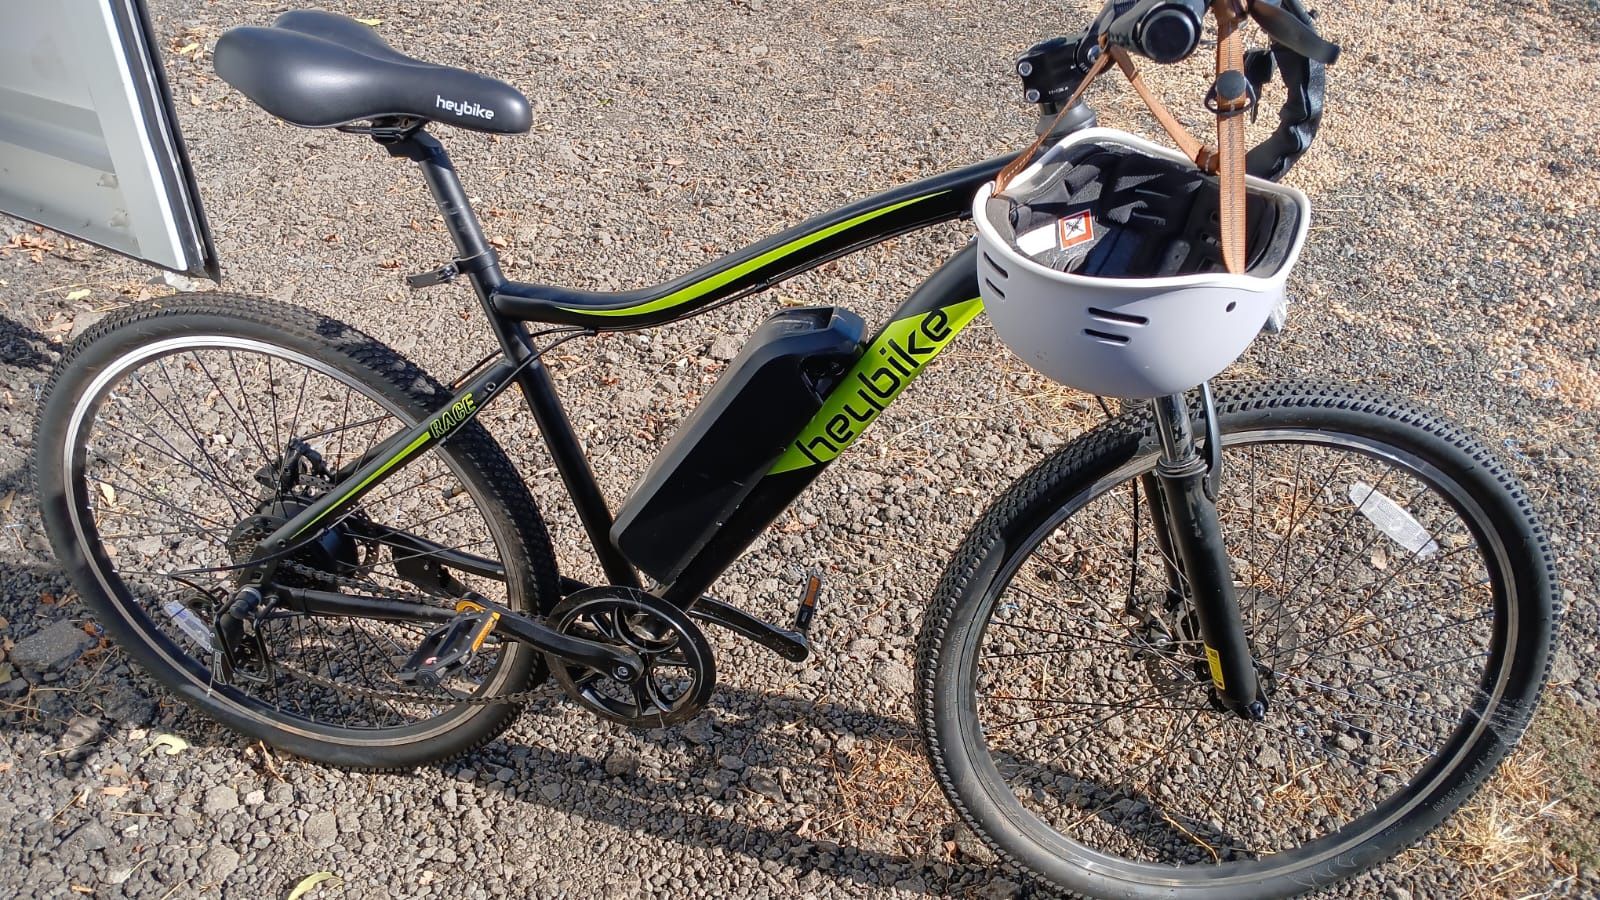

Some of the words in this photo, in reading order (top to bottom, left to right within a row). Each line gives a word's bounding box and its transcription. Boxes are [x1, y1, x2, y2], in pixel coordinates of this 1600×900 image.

[435, 94, 495, 120] heybike
[795, 308, 953, 464] heybike
[429, 392, 477, 439] RACE
